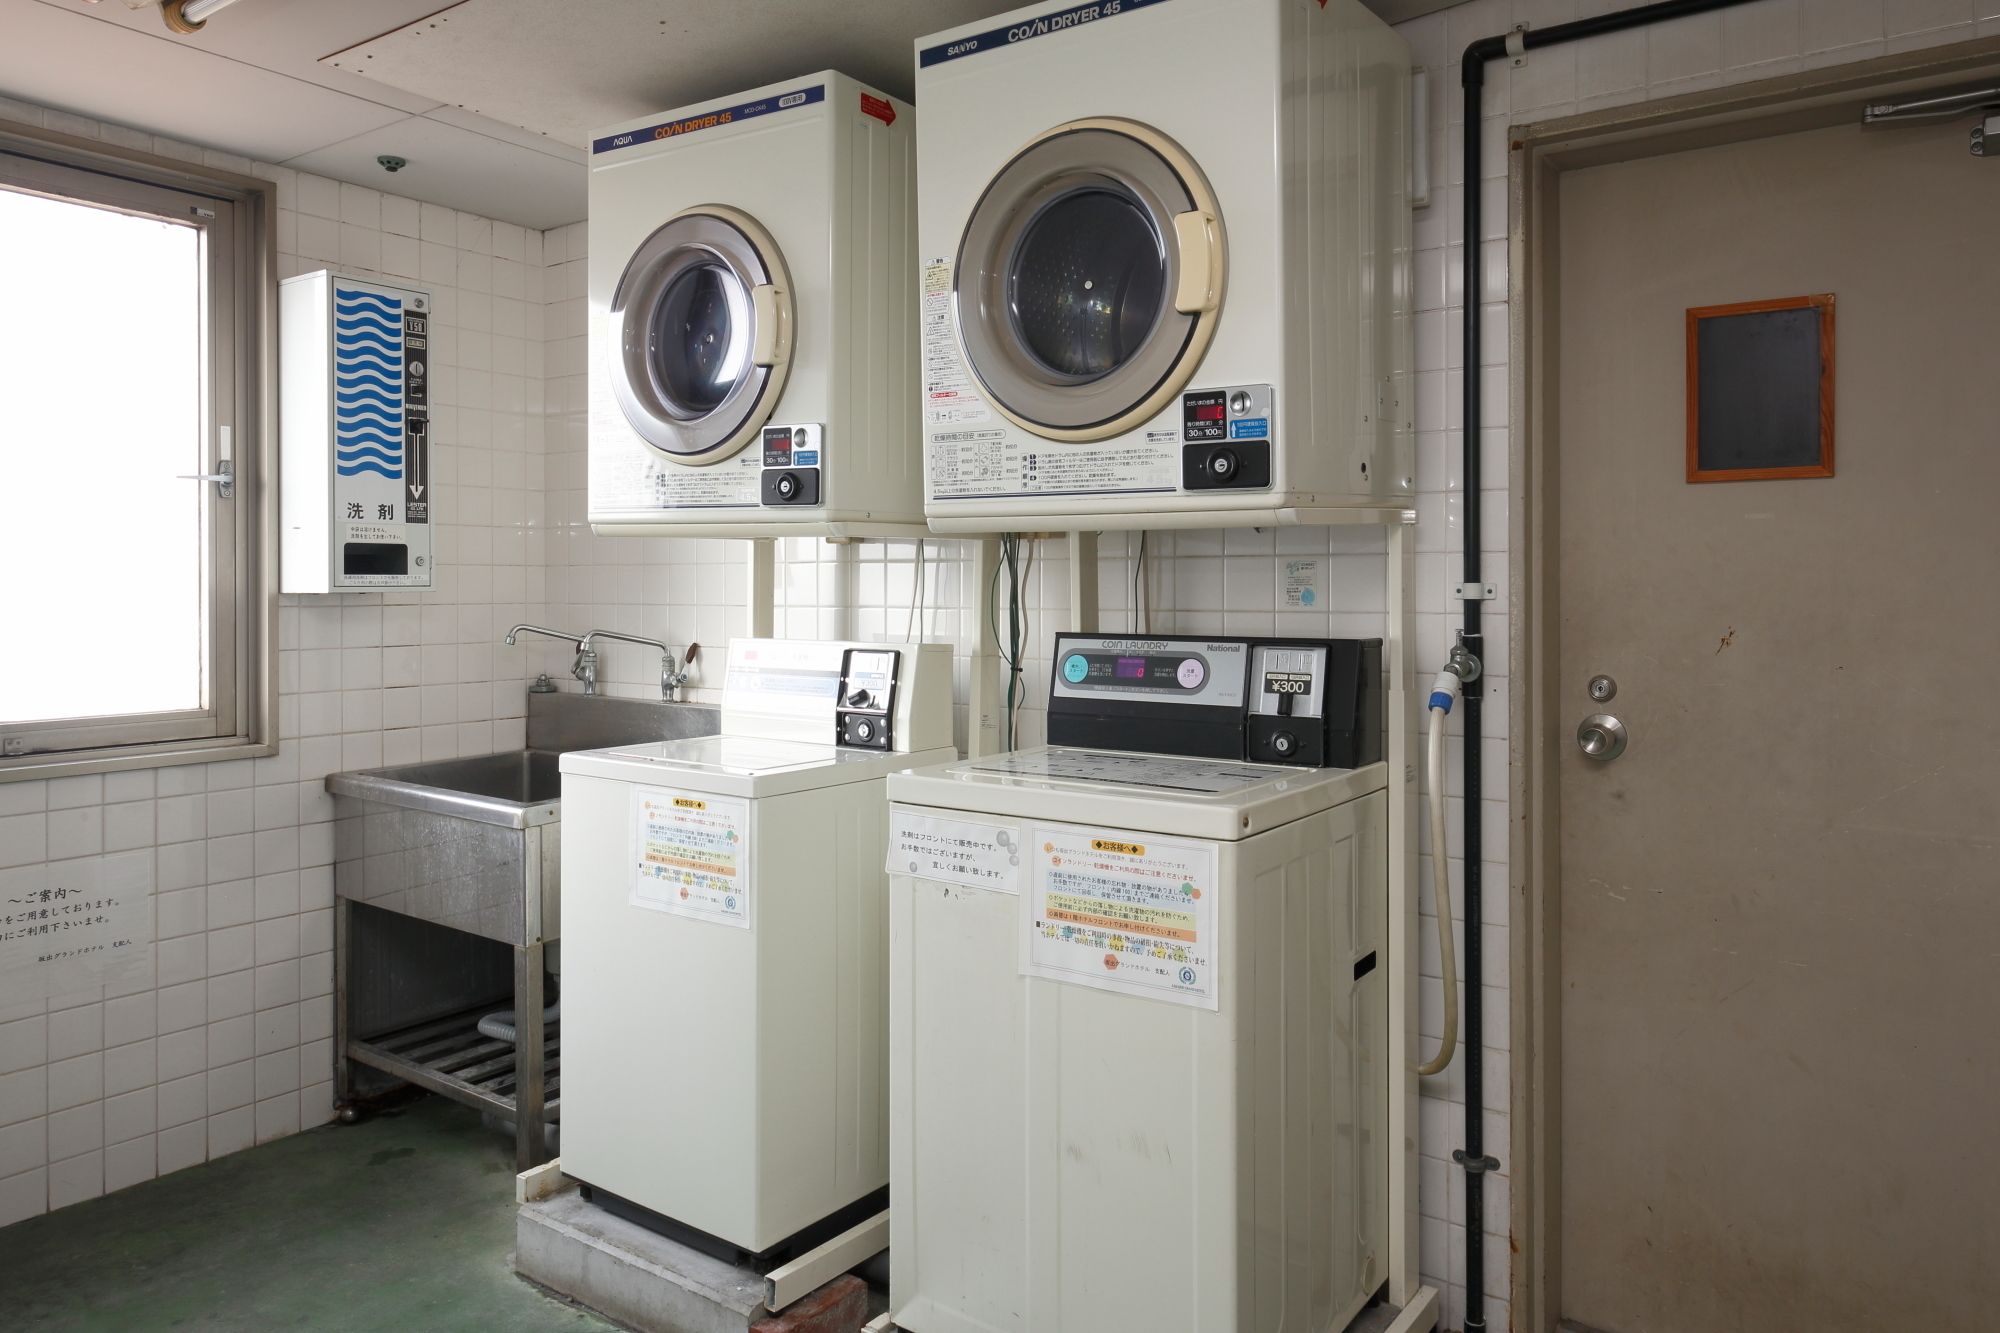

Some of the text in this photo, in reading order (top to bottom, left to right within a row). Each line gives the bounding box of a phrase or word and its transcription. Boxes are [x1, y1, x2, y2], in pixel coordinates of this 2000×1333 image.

[947, 1, 1120, 56] SANYO COIN DRYER 45
[613, 135, 633, 146] AQUA
[655, 122, 683, 139] COIN
[685, 115, 718, 132] DRYER
[719, 112, 732, 123] 45
[347, 502, 394, 520] 洗剤
[1102, 641, 1168, 650] COIN LAUNDRY
[1206, 644, 1240, 653] National
[1272, 680, 1304, 693] ¥300
[900, 830, 997, 852] 洗剤はフロントにて販売中です。
[0, 898, 120, 924] をご用意しております。
